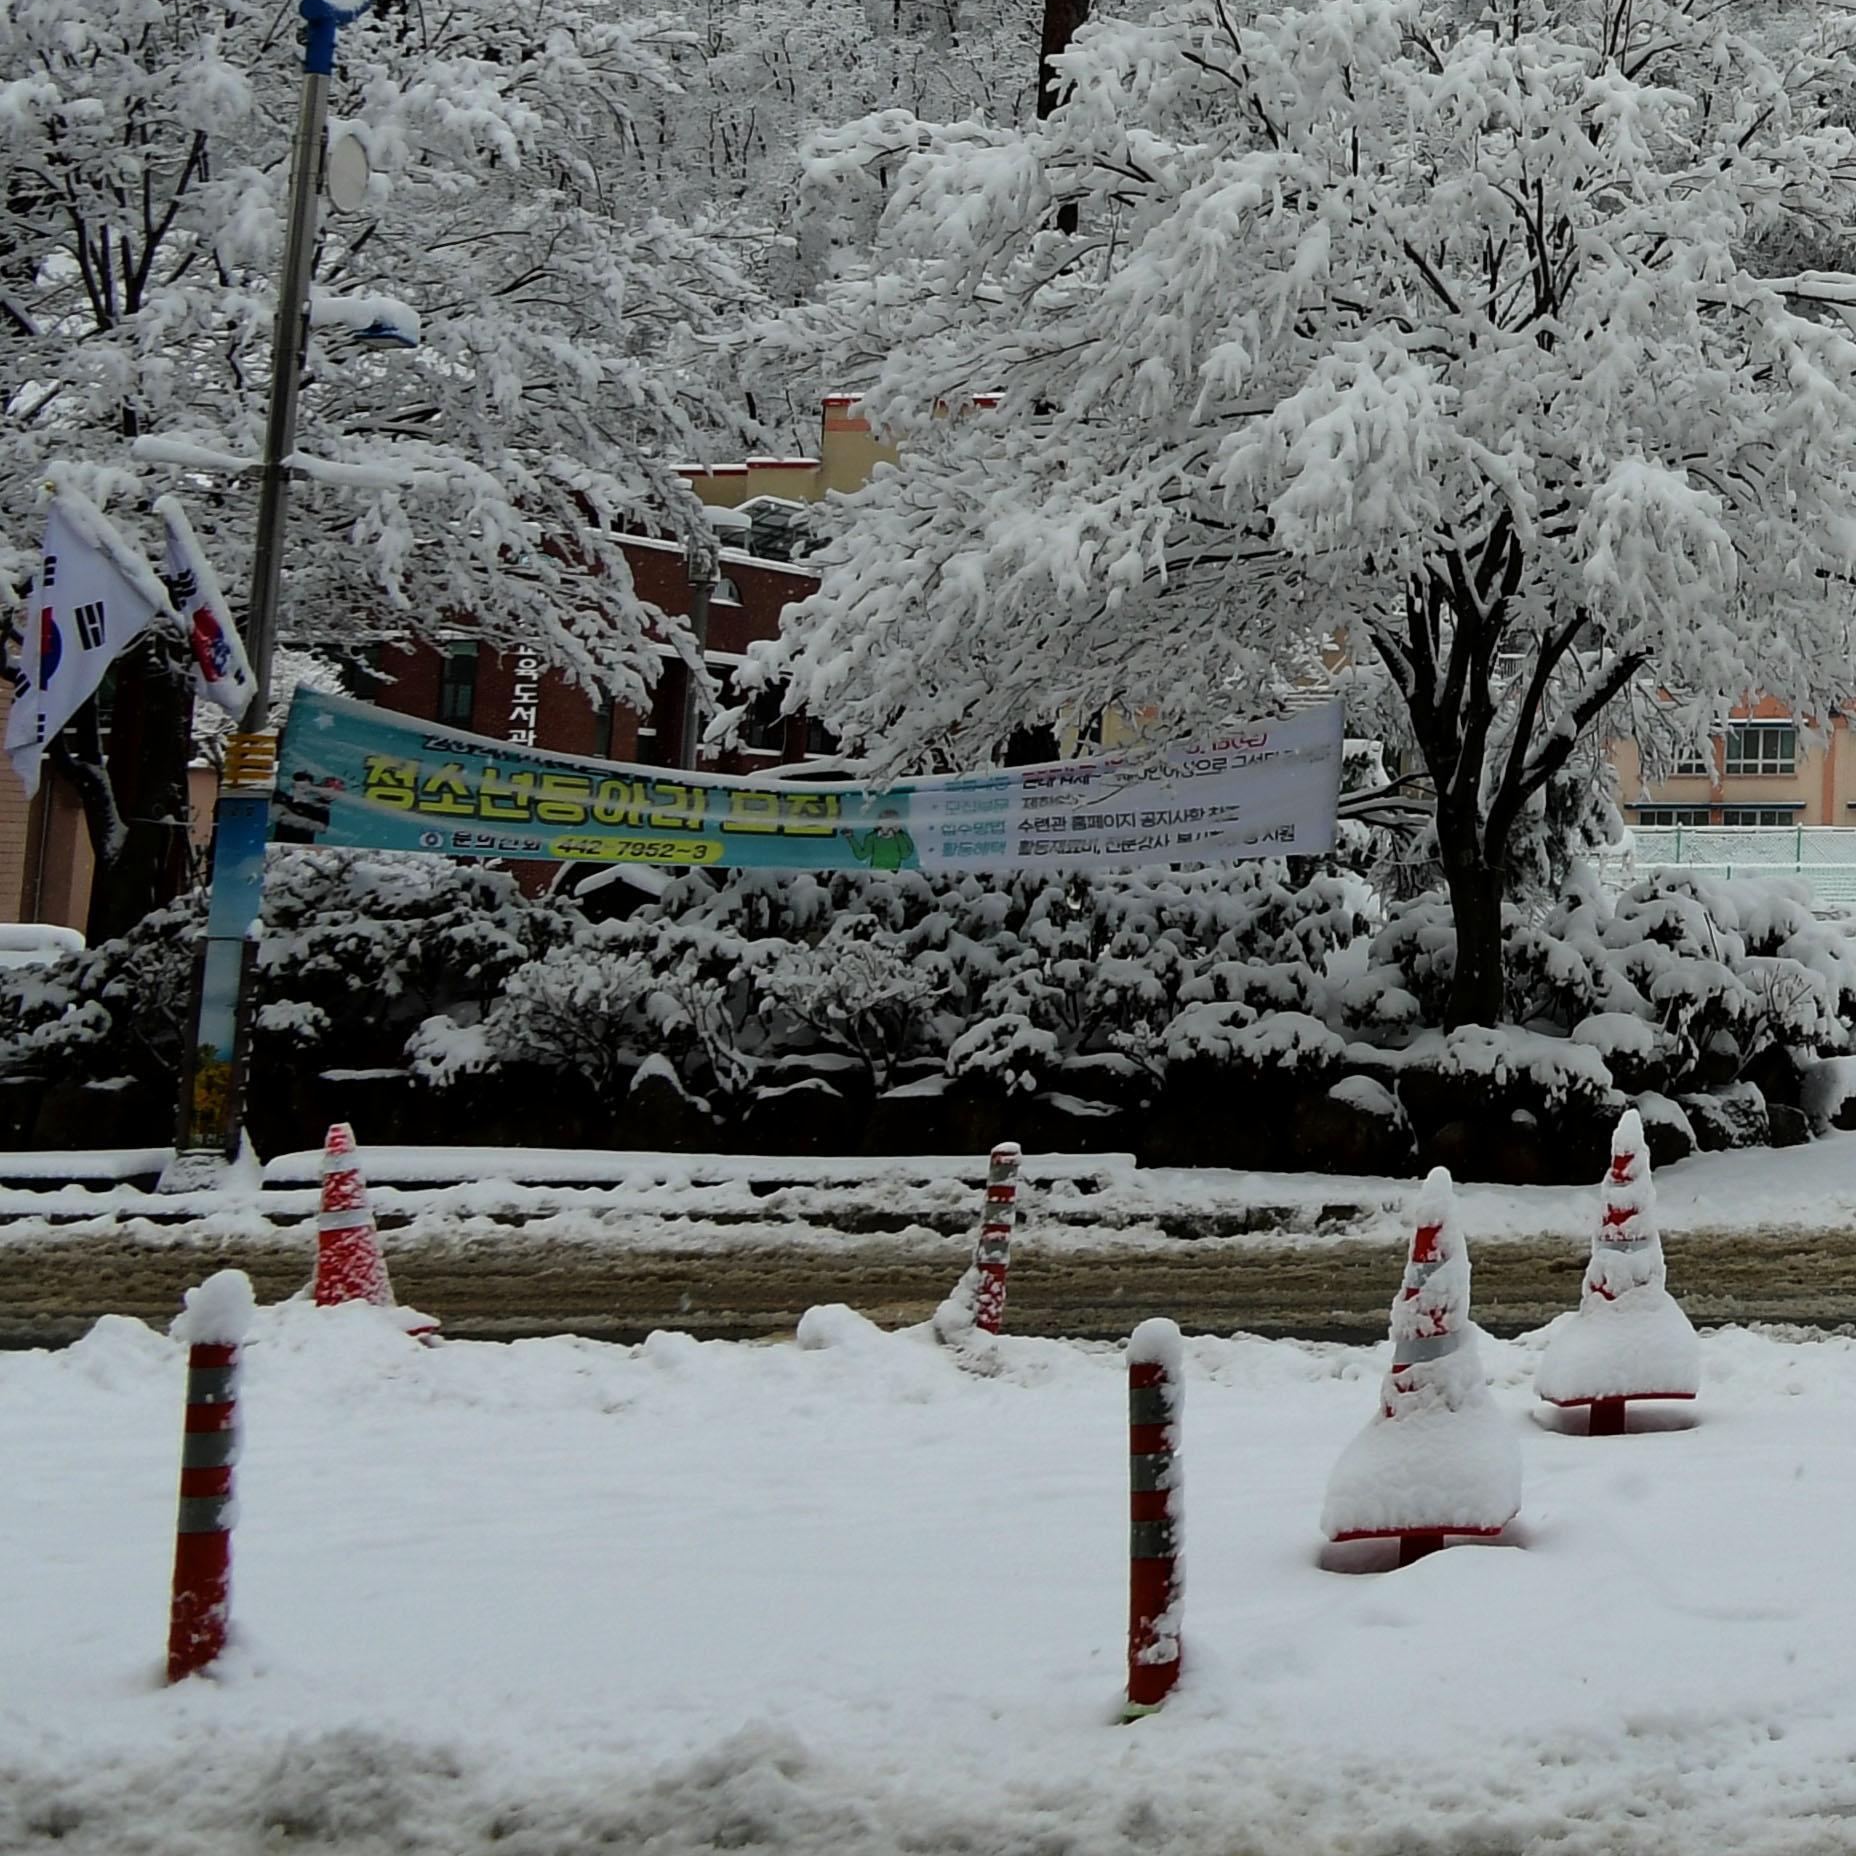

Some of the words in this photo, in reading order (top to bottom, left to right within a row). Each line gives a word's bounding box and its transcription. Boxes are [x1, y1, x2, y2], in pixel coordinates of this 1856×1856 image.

[362, 754, 704, 832] 청소년동아리
[721, 791, 840, 837] 모집
[1018, 817, 1066, 833] 수련관
[1071, 813, 1136, 832] 홈페이지
[1140, 808, 1206, 829] 공지사항
